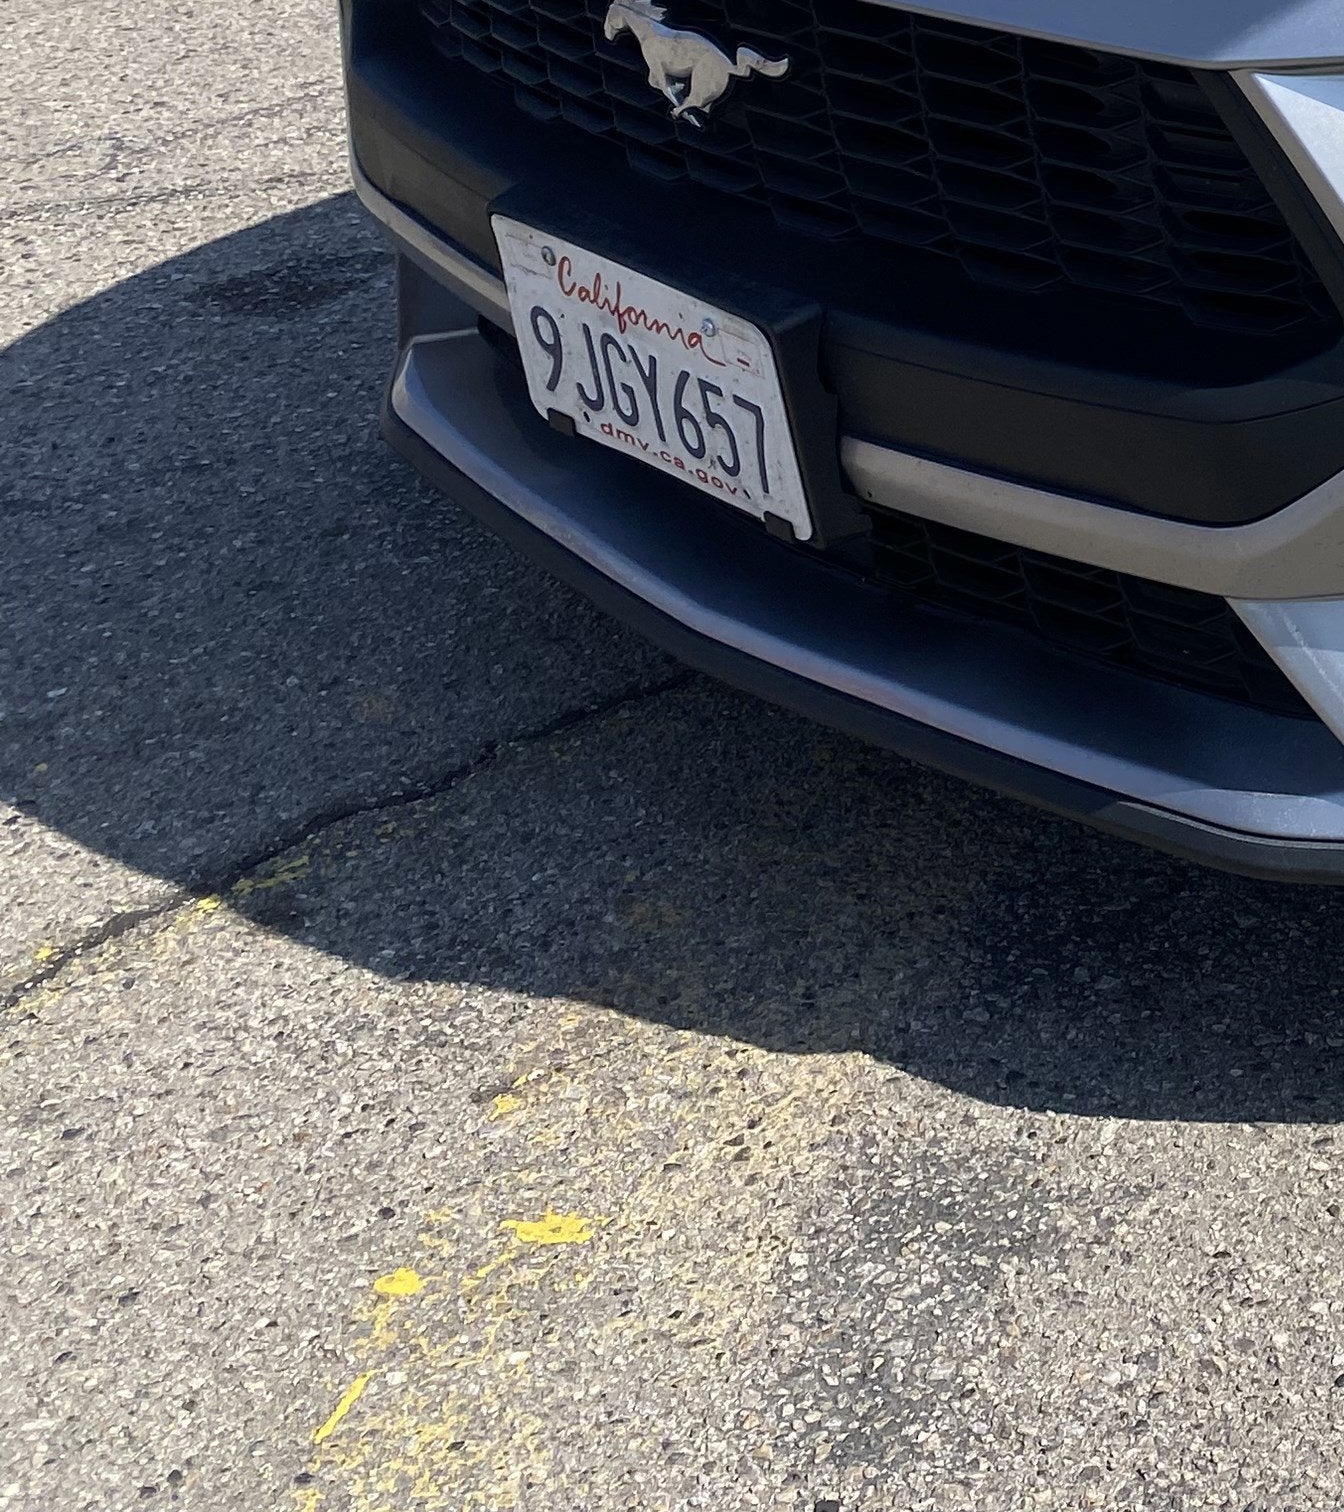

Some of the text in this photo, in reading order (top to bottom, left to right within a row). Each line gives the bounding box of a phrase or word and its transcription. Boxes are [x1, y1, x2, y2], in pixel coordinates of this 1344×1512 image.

[556, 255, 727, 367] California
[530, 305, 770, 494] 9JGY657
[600, 421, 738, 497] dmv.ca.gov
